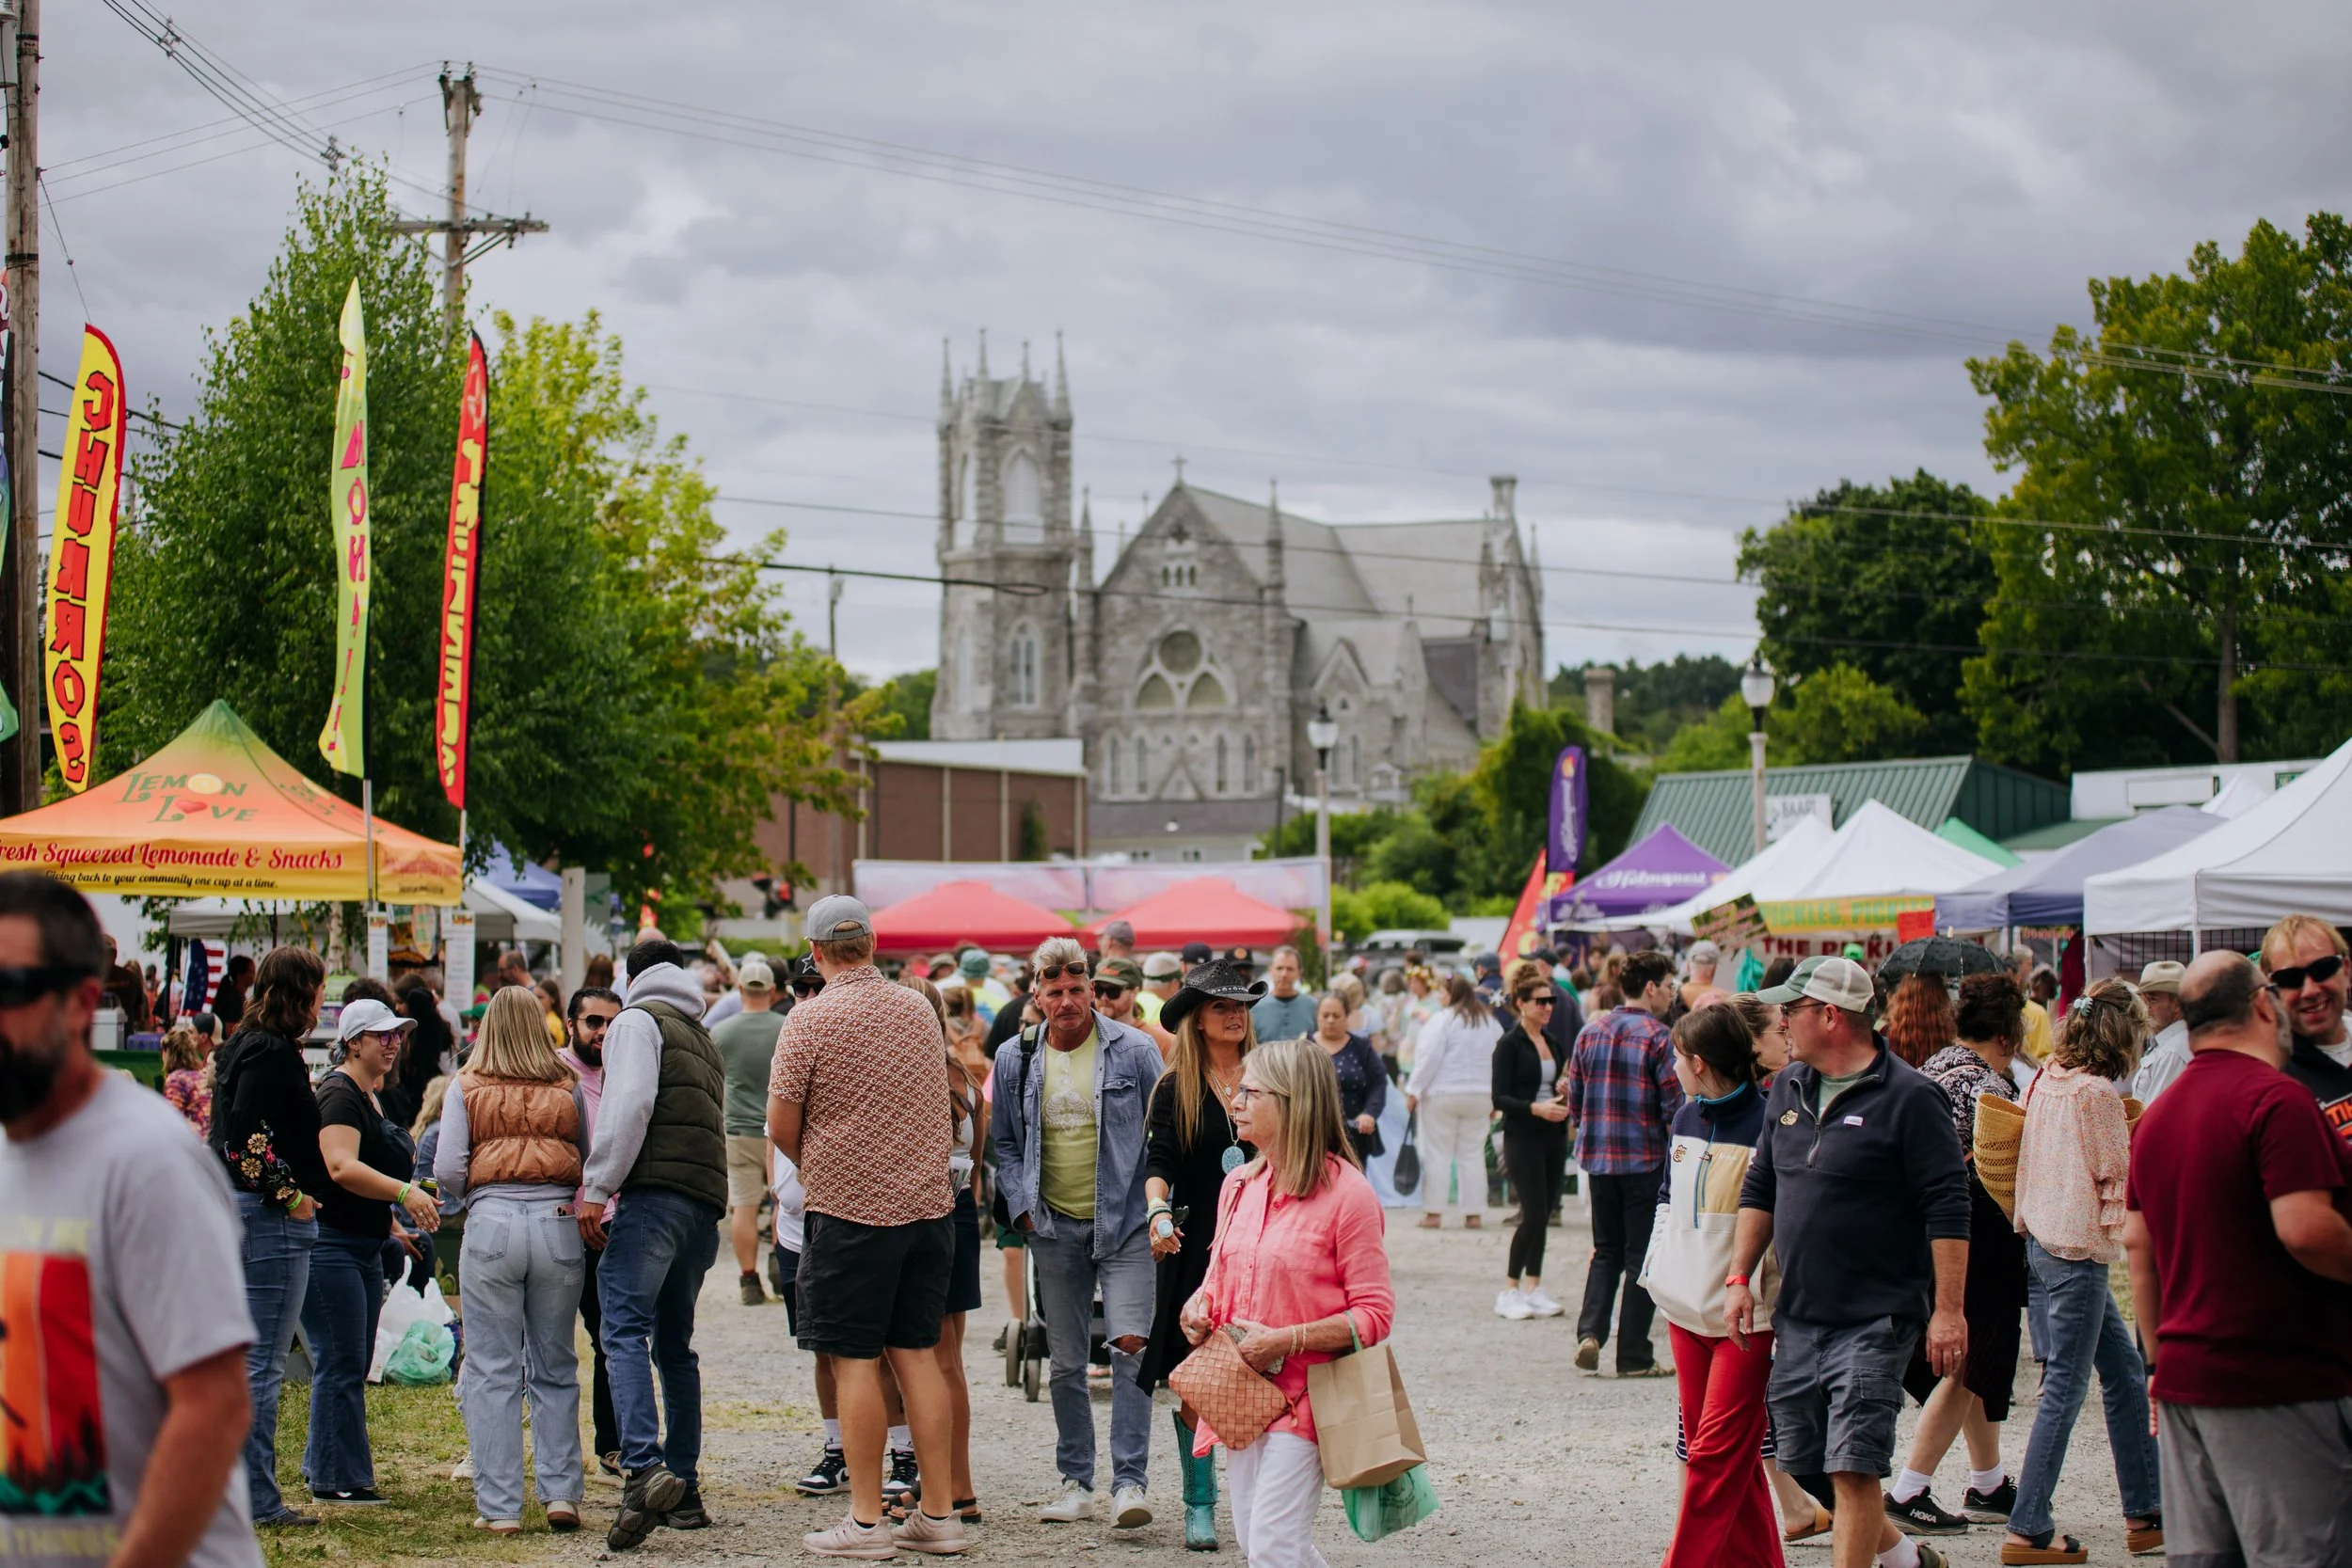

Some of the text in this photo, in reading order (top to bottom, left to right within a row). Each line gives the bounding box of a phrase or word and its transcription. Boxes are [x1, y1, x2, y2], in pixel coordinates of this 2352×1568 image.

[0, 841, 342, 870] resh Squeezed Lemonade & Snacks
[45, 869, 278, 890] Giving back to your community one cup at a time.
[1762, 937, 1811, 957] THE
[1909, 1508, 1937, 1524] HOKA
